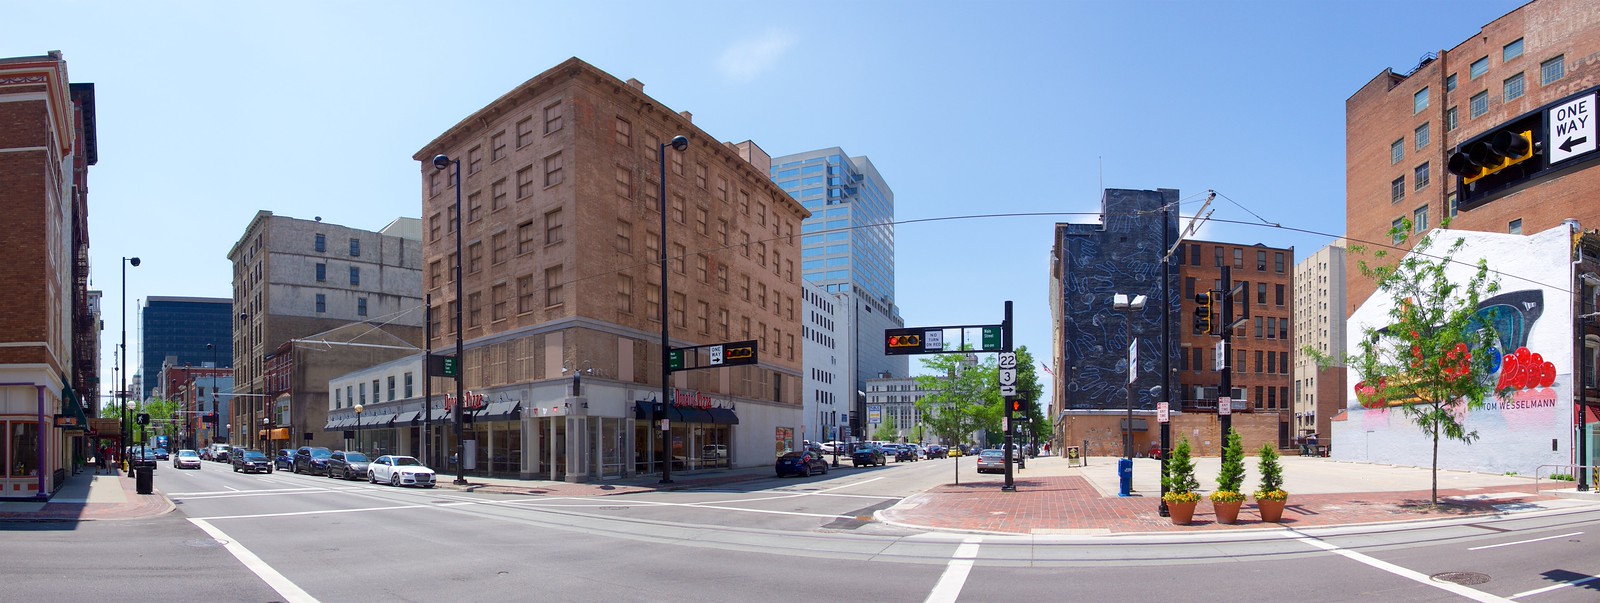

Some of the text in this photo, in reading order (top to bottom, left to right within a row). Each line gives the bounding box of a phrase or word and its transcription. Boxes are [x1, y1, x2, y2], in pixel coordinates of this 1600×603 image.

[1557, 101, 1587, 121] ONE
[1556, 115, 1588, 137] WAY
[1001, 356, 1014, 365] 22
[1004, 372, 1010, 381] 3
[1500, 399, 1555, 410] WESSELMANN
